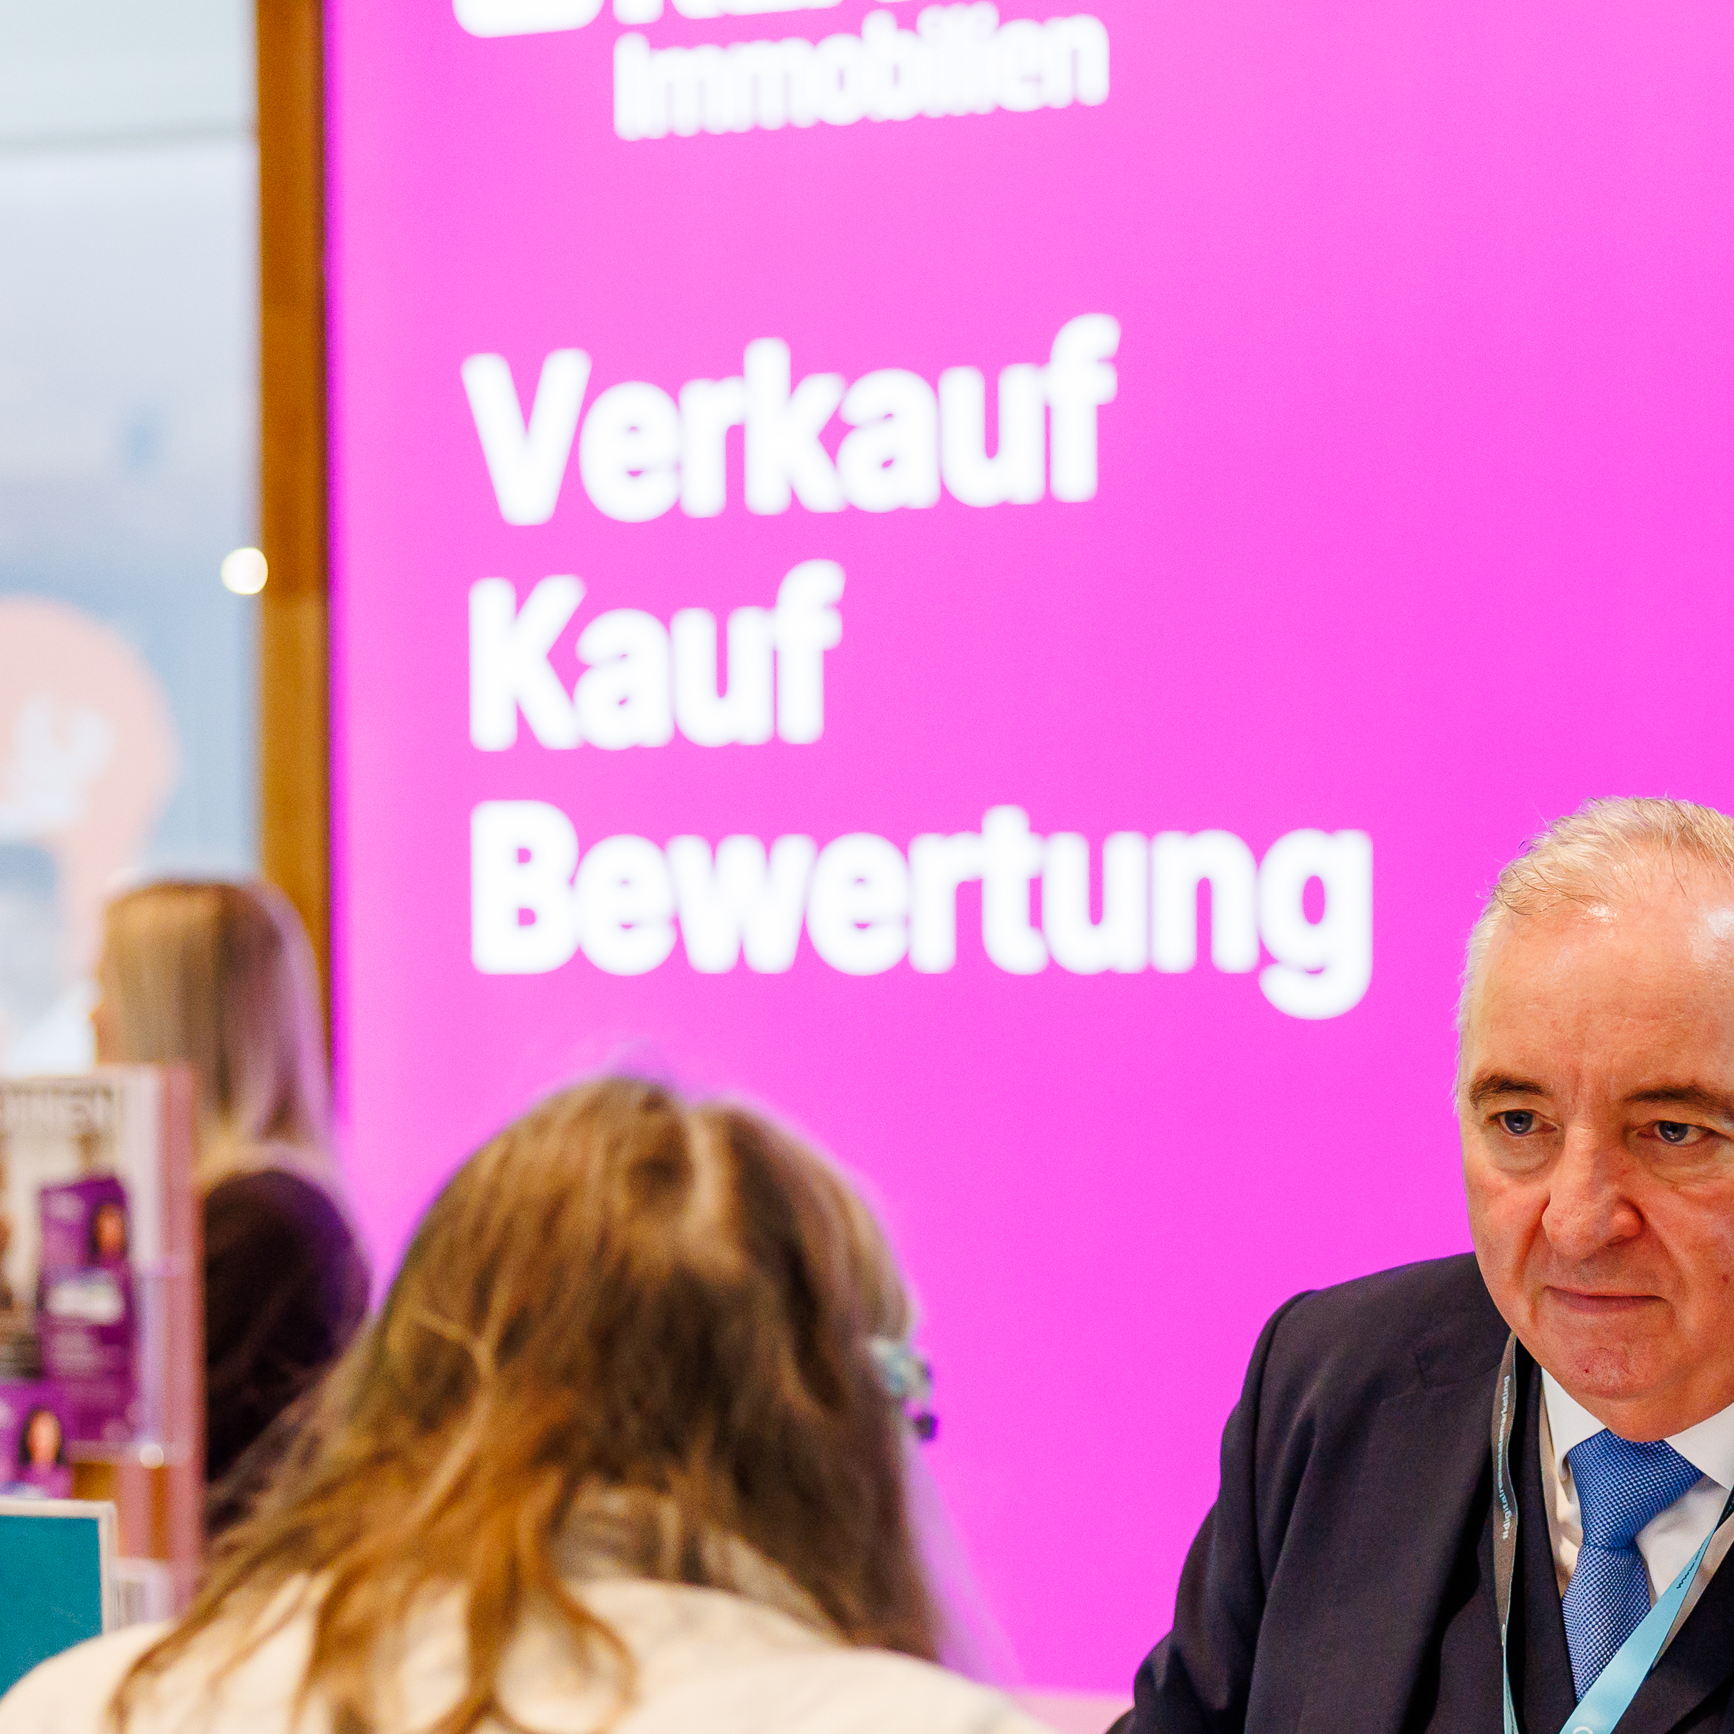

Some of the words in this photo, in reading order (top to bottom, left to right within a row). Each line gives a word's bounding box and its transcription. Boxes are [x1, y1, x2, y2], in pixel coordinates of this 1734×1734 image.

[613, 2, 1111, 142] Immobilien
[460, 312, 1121, 527] Verkauf
[467, 559, 847, 752] Kauf
[469, 799, 1373, 1020] Bewertung
